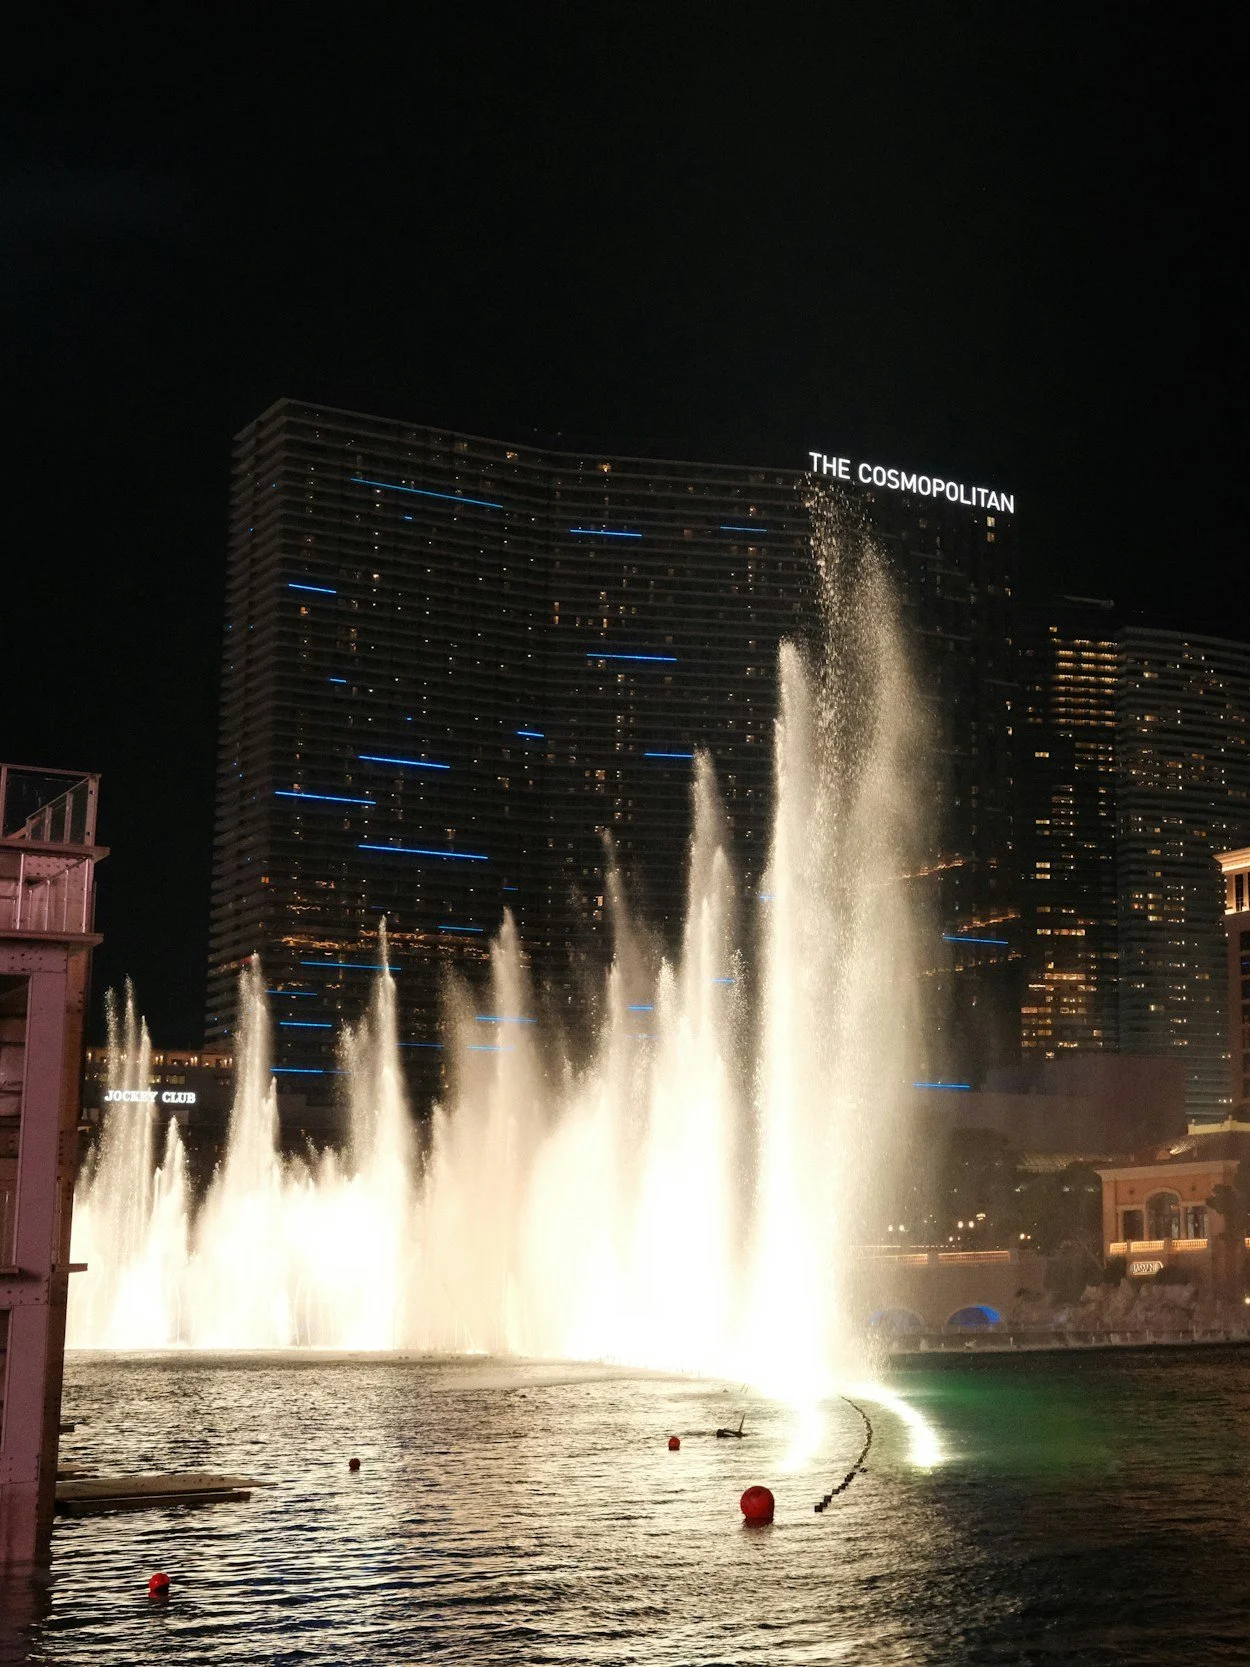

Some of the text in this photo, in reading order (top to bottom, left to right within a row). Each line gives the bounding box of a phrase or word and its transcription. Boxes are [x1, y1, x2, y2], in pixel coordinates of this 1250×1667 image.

[808, 451, 1015, 514] THE COSMOPOLITAN
[104, 1090, 196, 1104] JOCKEY CLUB
